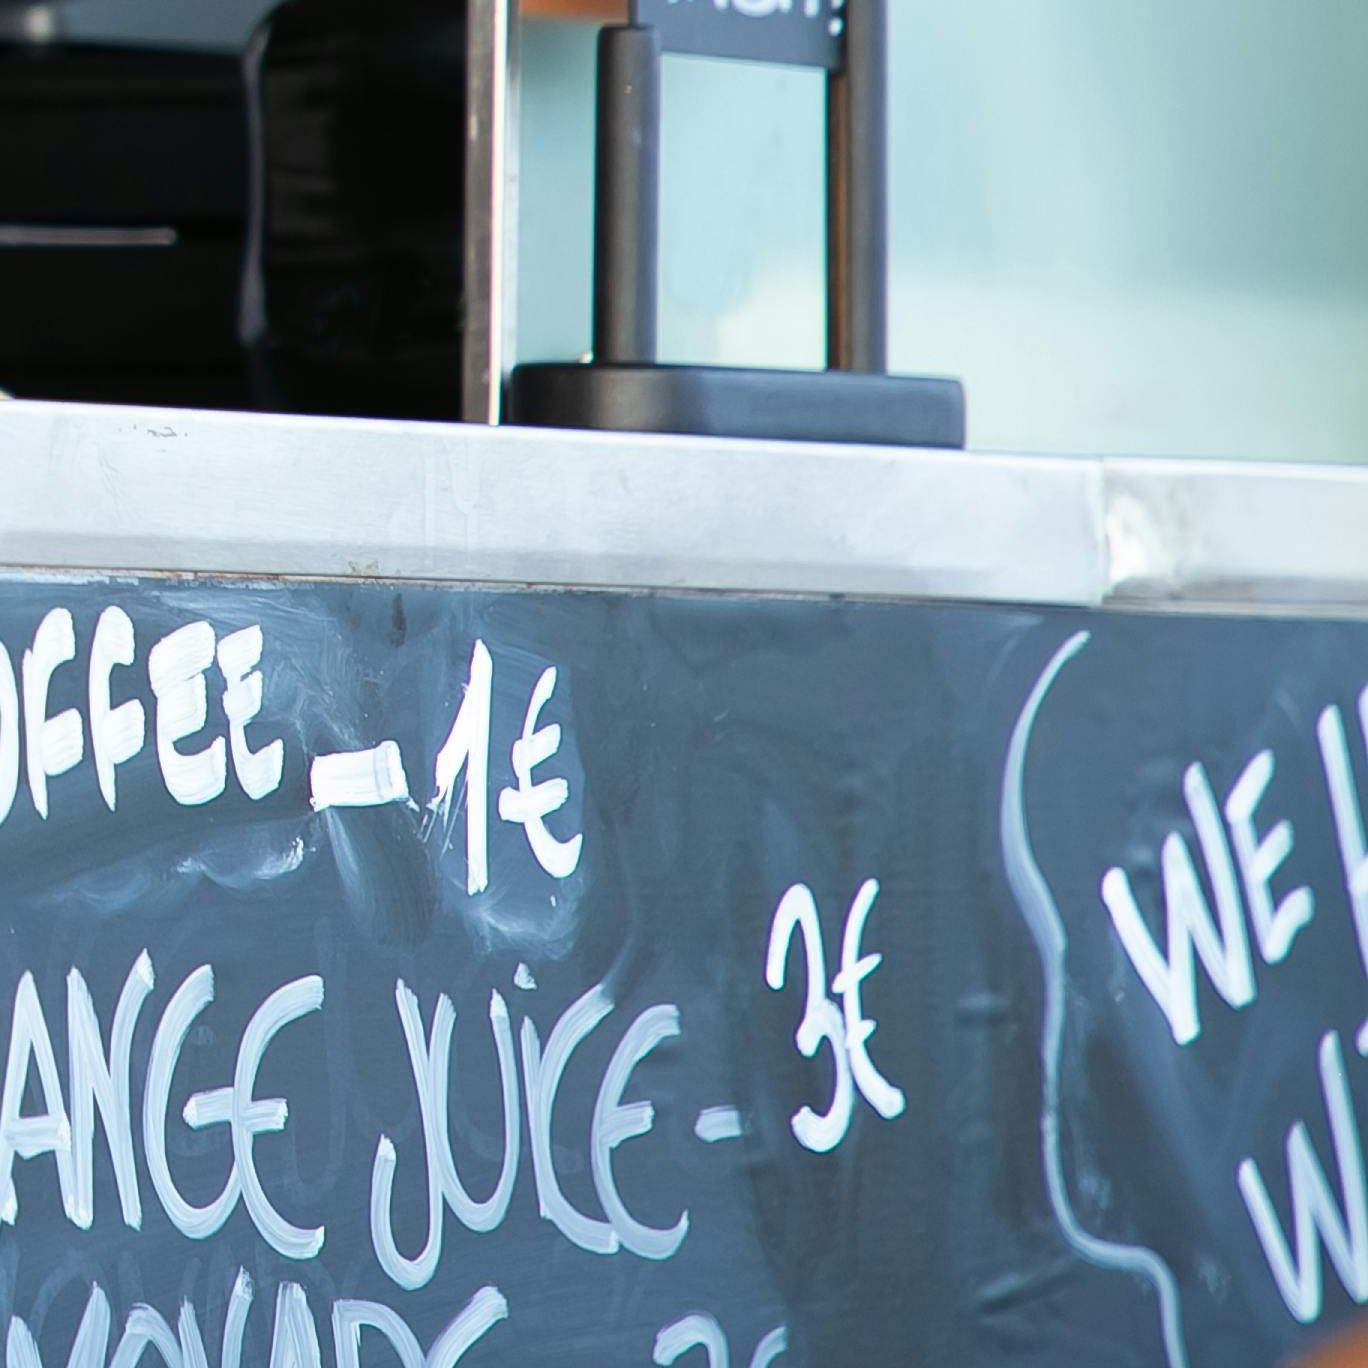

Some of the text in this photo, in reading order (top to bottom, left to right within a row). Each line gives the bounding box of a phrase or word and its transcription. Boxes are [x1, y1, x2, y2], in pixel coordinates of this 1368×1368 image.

[424, 637, 584, 897] 1€
[1100, 748, 1315, 1046] WE
[764, 877, 905, 1153] 3€
